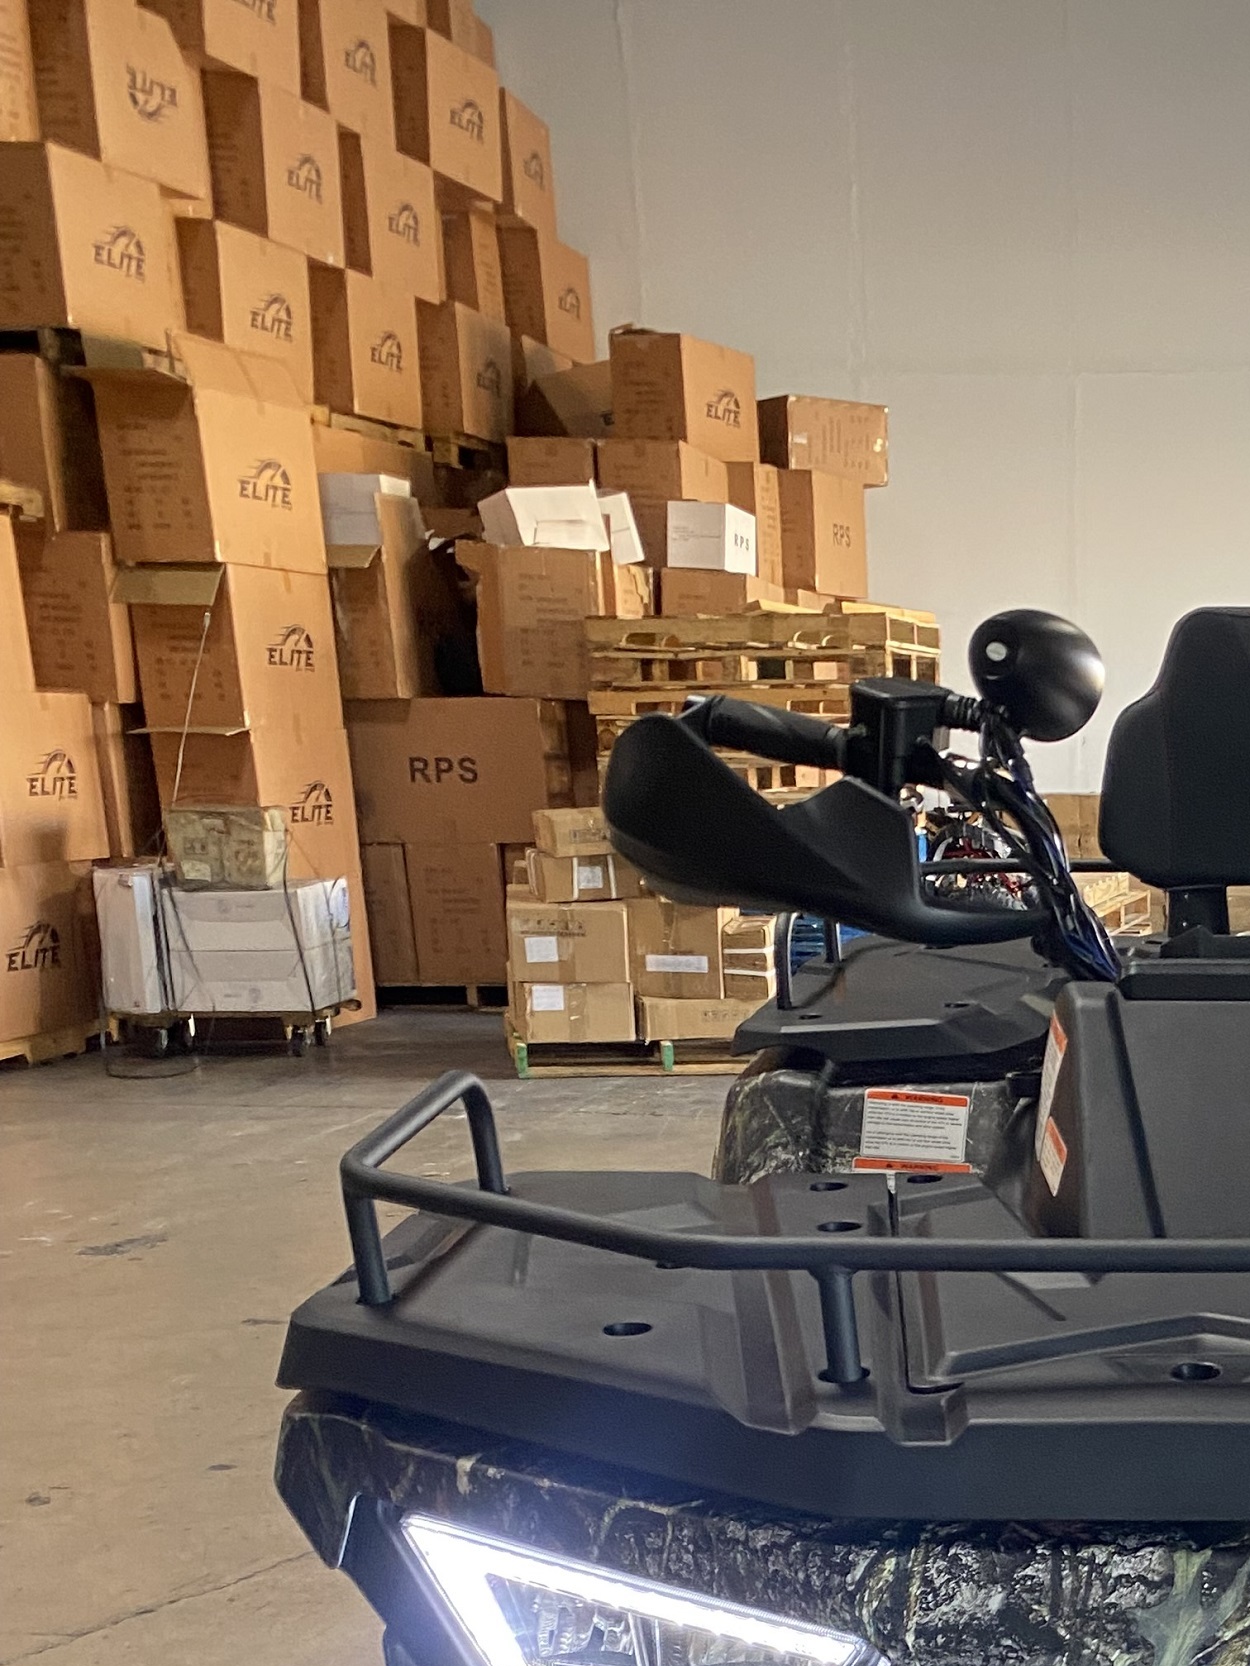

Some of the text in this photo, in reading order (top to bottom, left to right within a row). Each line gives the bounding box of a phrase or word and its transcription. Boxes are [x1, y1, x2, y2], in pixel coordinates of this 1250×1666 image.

[127, 65, 178, 107] ELITE
[449, 108, 483, 142] ELITE
[287, 169, 323, 203] ELITE
[388, 216, 419, 244] ELITE
[91, 243, 145, 279] ELITE
[250, 310, 292, 338] ELITE
[370, 346, 402, 371] ELITE
[706, 403, 740, 425] ELITE
[238, 478, 292, 505] ELITE
[734, 533, 749, 551] RPS
[833, 523, 851, 549] RPS
[266, 648, 314, 667] ELITE
[408, 756, 478, 784] RPS
[26, 776, 77, 797] ELITE
[289, 804, 333, 823] ELITE
[6, 944, 61, 972] ELITE
